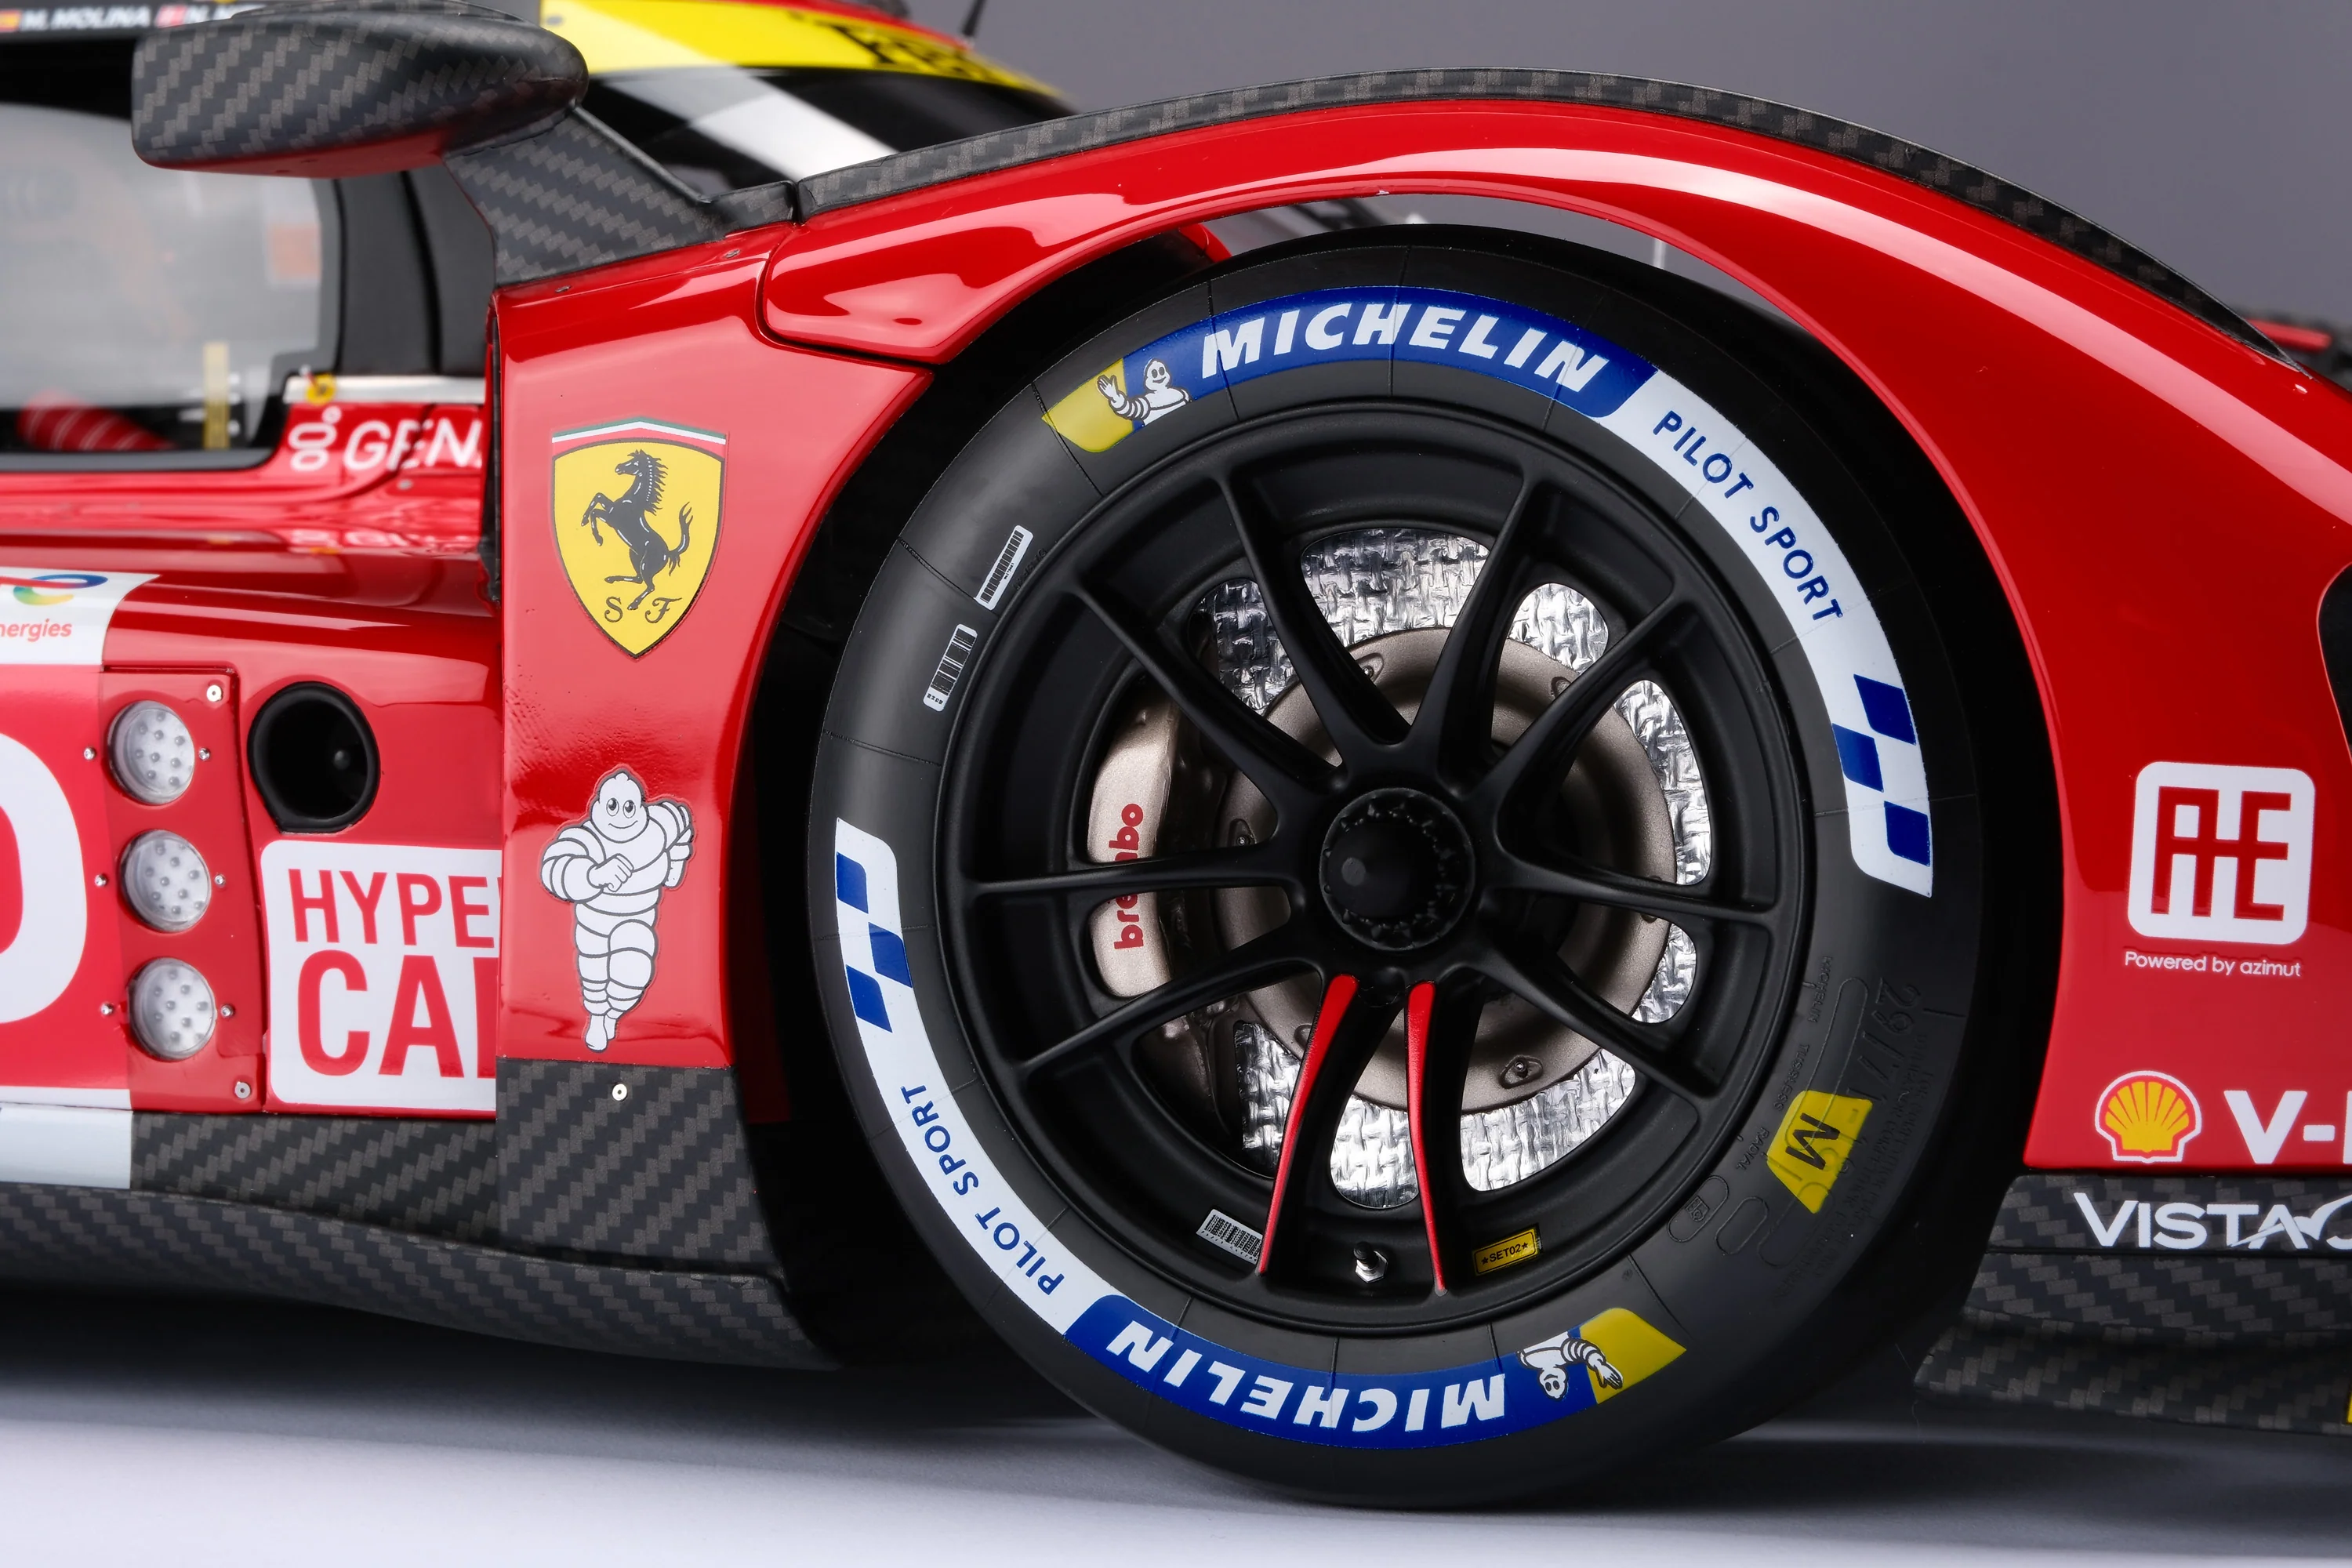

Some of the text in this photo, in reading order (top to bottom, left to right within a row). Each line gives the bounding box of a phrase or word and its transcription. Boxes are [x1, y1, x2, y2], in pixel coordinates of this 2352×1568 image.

[51, 7, 151, 29] MOLINA
[1202, 303, 1610, 394] MICHELIN
[343, 417, 483, 470] GEN
[1652, 410, 1844, 621] PILOT SPORT
[604, 596, 623, 622] S
[288, 868, 502, 949] HYPE
[1109, 803, 1145, 950] brebo
[2125, 951, 2301, 978] Powered by azimut
[1785, 1113, 1840, 1171] M
[2223, 1091, 2352, 1164] V-
[901, 1085, 1064, 1295] PILOT SPORT
[1105, 1320, 1505, 1433] MICHELIN
